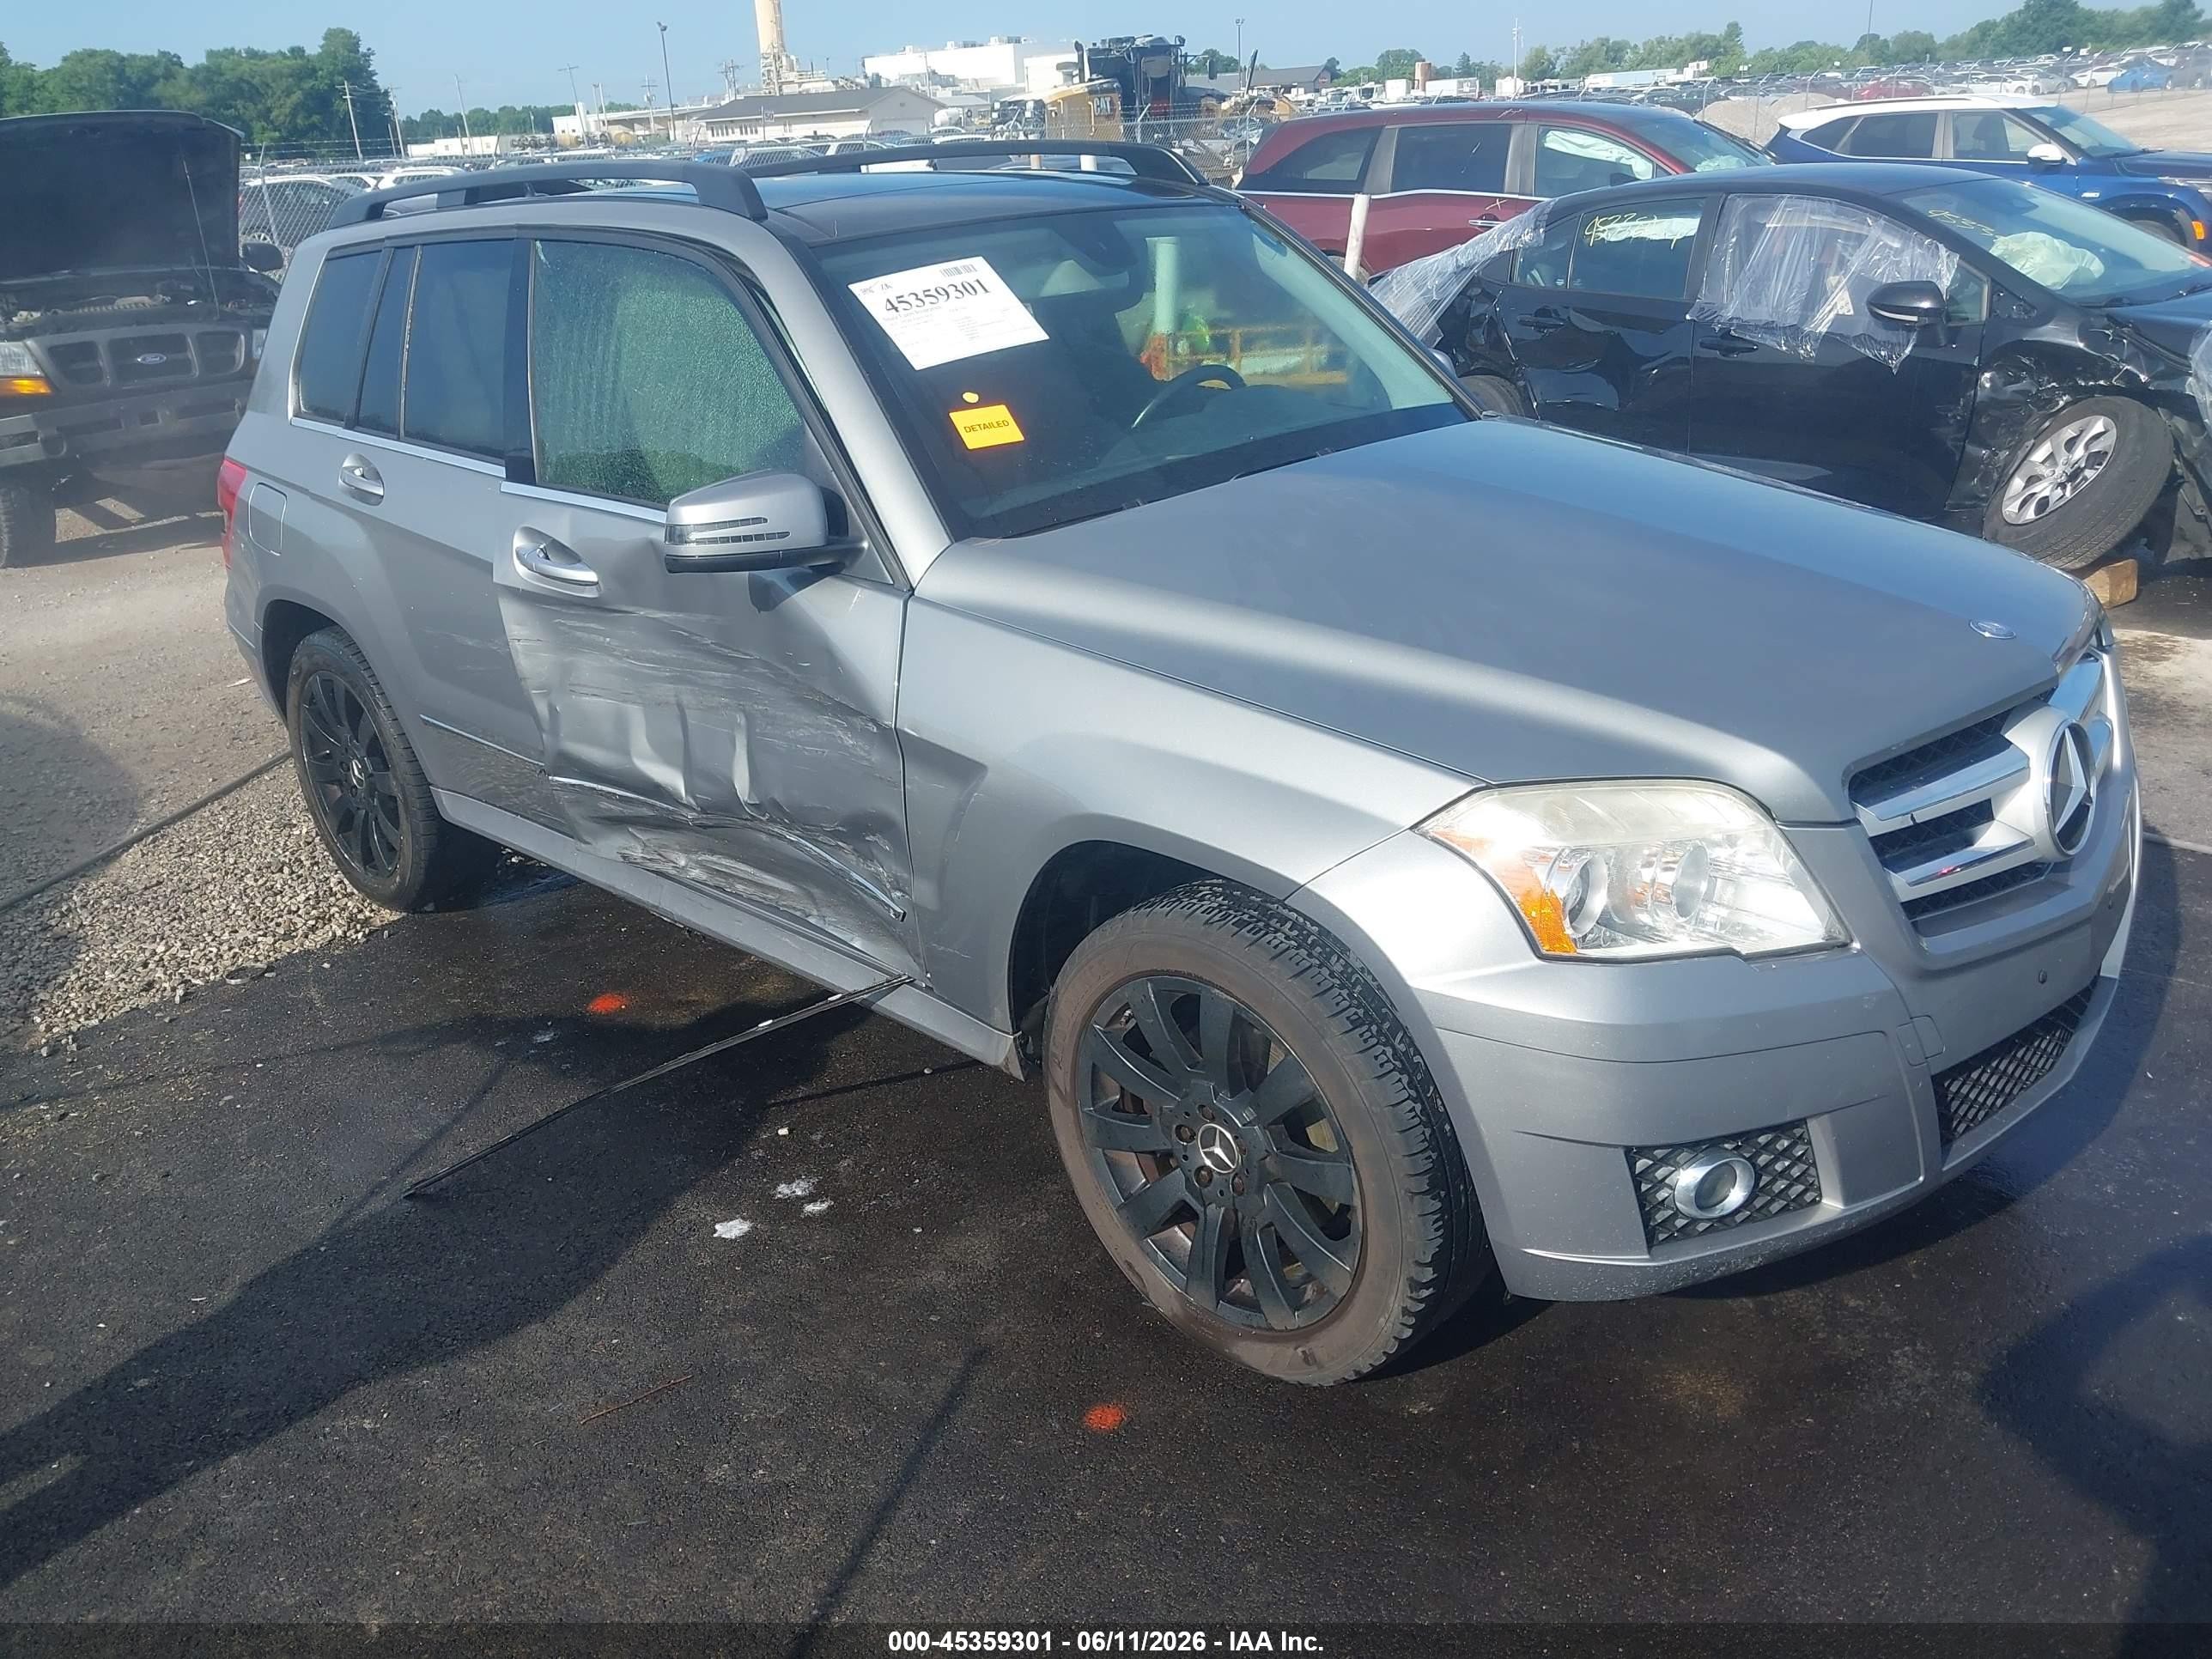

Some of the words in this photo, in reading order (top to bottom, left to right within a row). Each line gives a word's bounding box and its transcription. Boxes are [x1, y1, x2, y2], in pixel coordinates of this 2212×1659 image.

[1093, 95, 1112, 117] CAT
[884, 277, 991, 314] 45359301
[963, 419, 1010, 434] DETAILED
